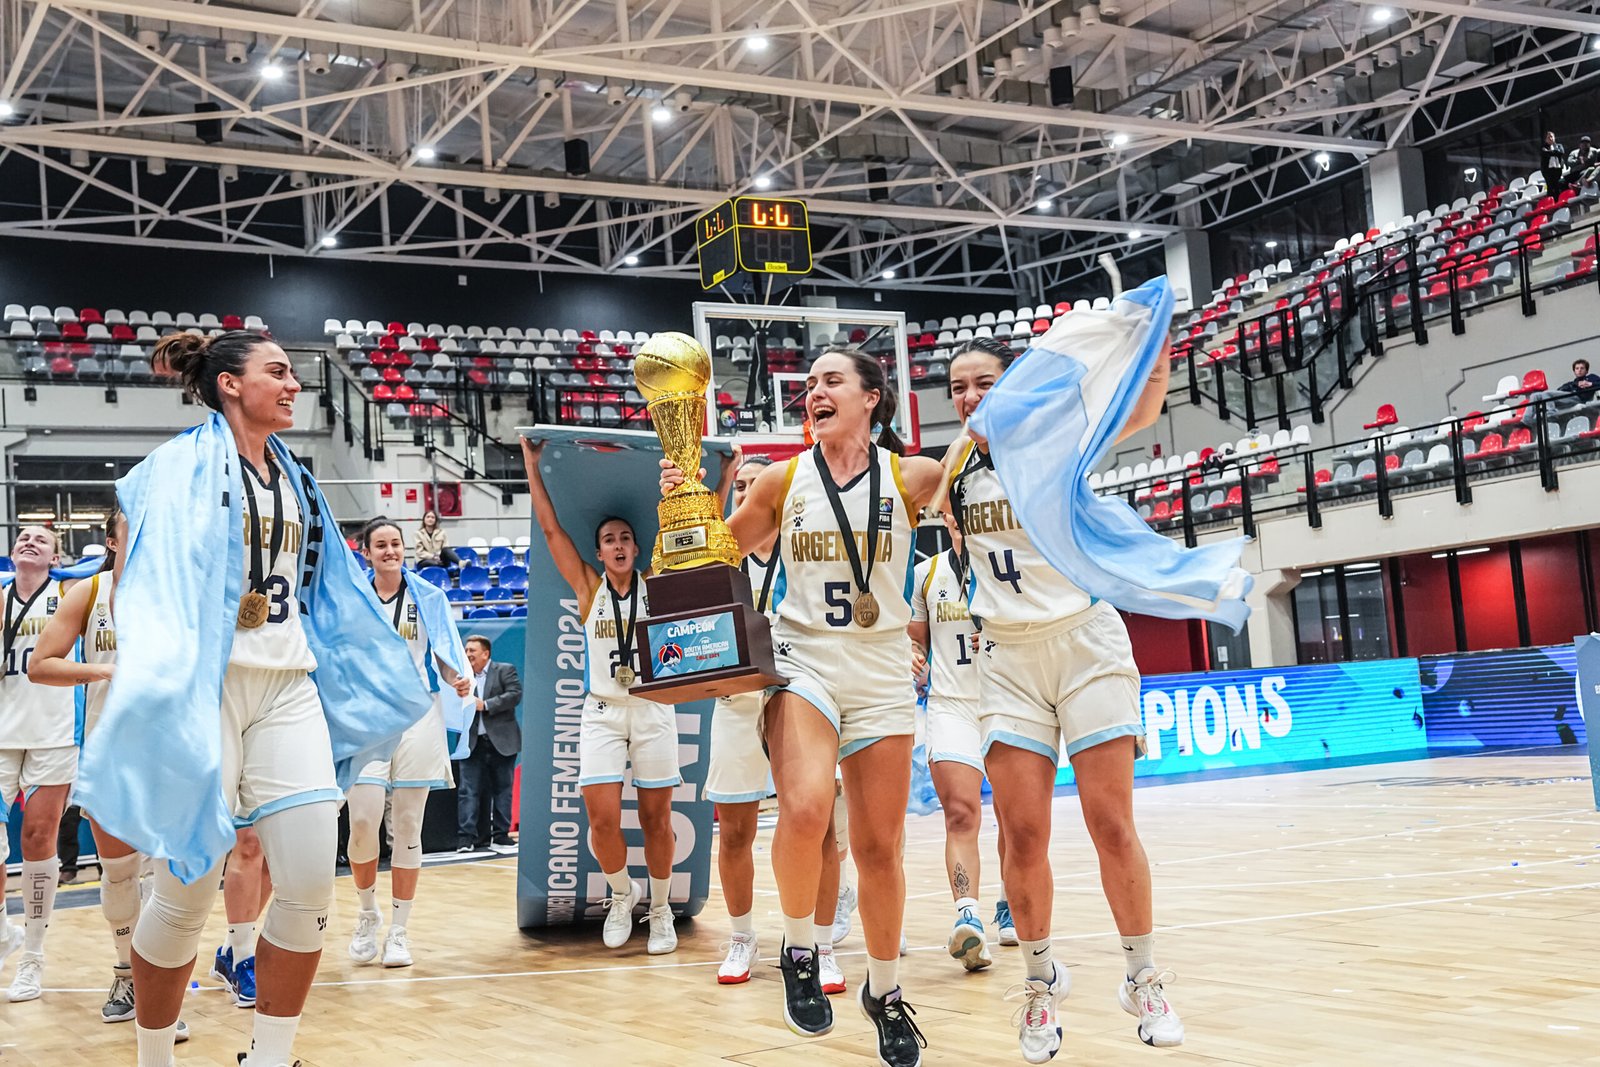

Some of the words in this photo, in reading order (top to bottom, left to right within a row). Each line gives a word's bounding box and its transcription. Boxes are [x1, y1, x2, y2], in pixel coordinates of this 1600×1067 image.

[824, 582, 852, 627] 5
[988, 549, 1022, 594] 4
[556, 599, 585, 671] 2024
[551, 678, 585, 814] FEMENINO
[1142, 676, 1292, 760] PIONS
